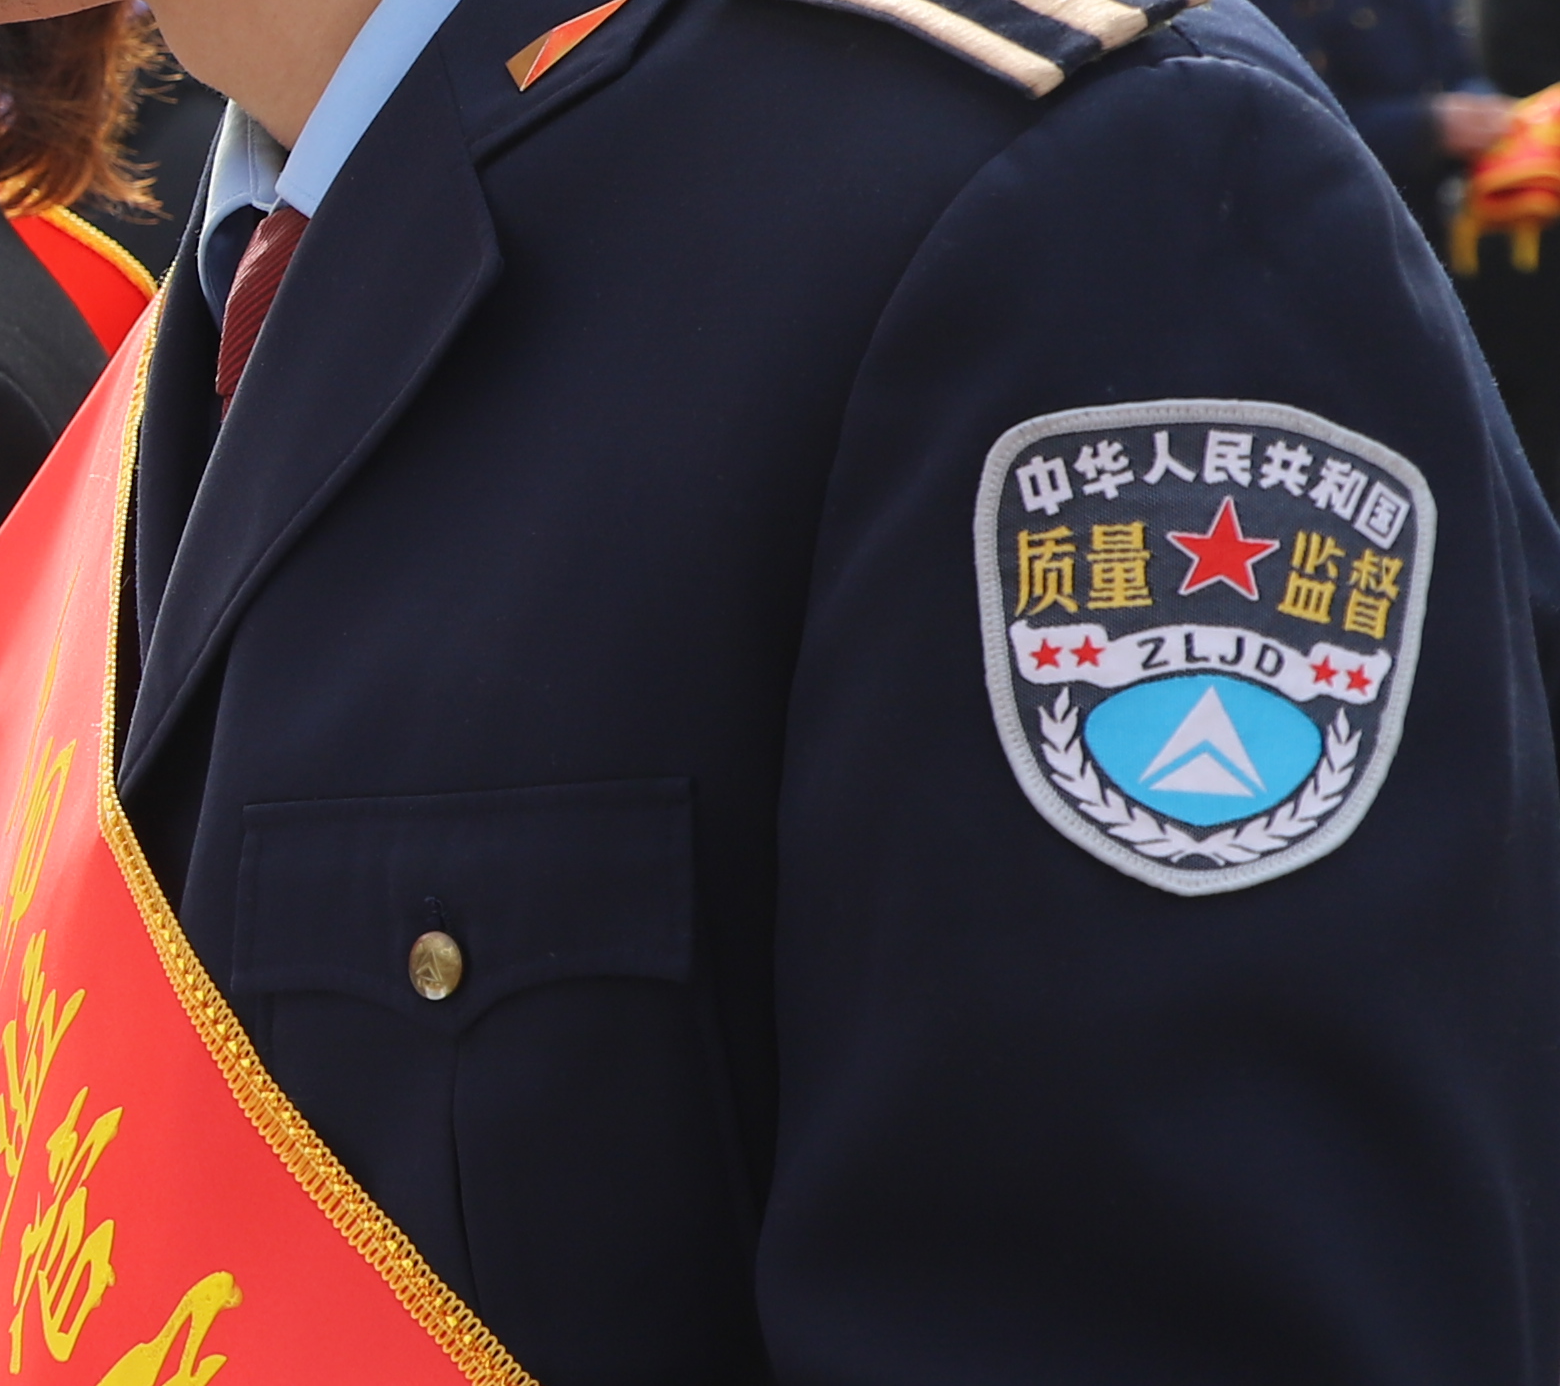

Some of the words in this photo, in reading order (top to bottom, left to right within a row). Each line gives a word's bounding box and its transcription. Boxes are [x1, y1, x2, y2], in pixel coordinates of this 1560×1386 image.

[1015, 428, 1411, 549] 中华人民共和国
[1013, 521, 1155, 618] 质量
[1276, 530, 1405, 641] 监督
[1135, 632, 1287, 679] ZLJD
